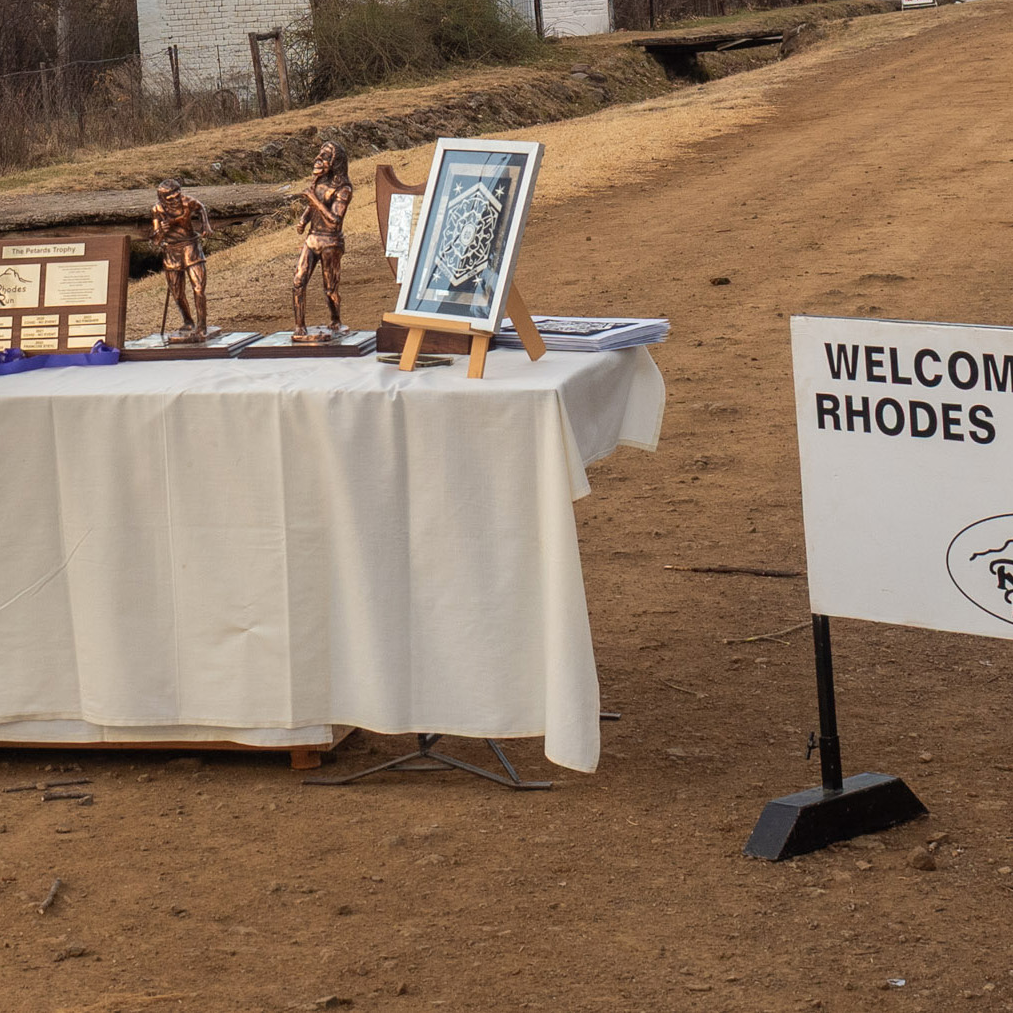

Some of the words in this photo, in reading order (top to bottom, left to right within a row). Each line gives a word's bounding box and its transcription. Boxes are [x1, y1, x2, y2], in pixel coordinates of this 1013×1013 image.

[53, 246, 76, 254] Trophy
[824, 343, 1013, 393] WELCOM
[815, 392, 996, 445] RHODES
